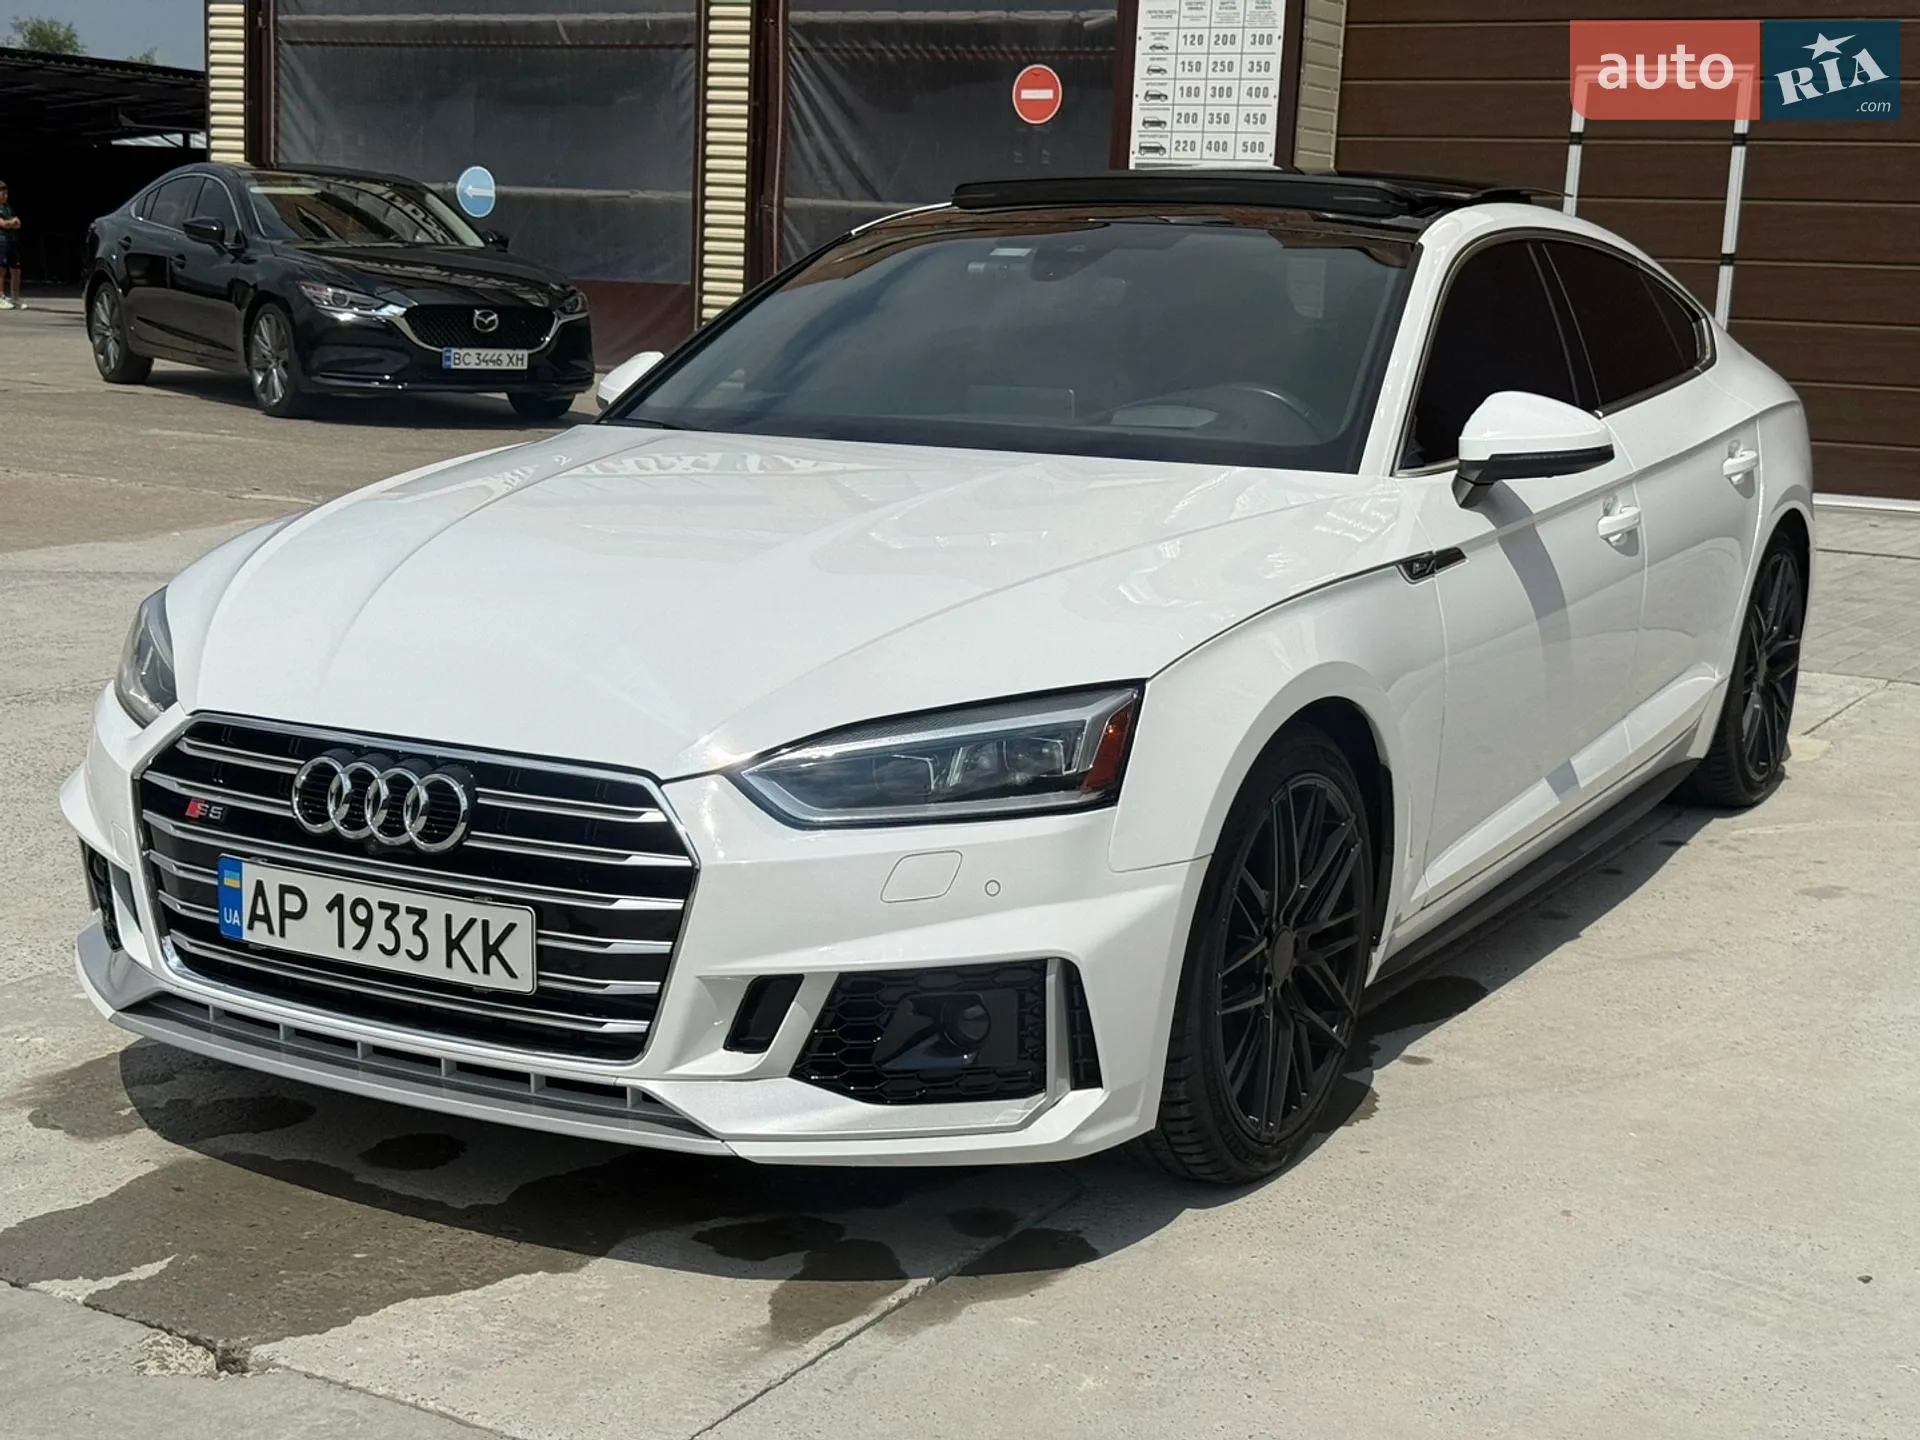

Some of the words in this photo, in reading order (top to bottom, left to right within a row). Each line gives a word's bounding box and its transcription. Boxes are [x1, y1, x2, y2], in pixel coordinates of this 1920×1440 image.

[1182, 34, 1204, 46] 120
[1213, 34, 1236, 46] 200
[1250, 34, 1273, 46] 300
[1180, 61, 1202, 73] 150
[1211, 61, 1234, 73] 250
[1247, 61, 1271, 73] 350
[1179, 86, 1201, 98] 180
[1210, 86, 1233, 98] 300
[1246, 86, 1269, 98] 400
[1176, 112, 1198, 124] 200
[1207, 113, 1230, 125] 350
[1243, 113, 1267, 125] 450
[1174, 140, 1196, 152] 220
[1205, 140, 1228, 152] 400
[1241, 141, 1265, 153] 500
[453, 352, 472, 366] BC
[474, 352, 503, 367] 3446
[506, 353, 525, 367] XH
[224, 907, 241, 926] UA
[247, 878, 308, 938] AP
[325, 893, 429, 961] 1933
[444, 912, 518, 979] KK
